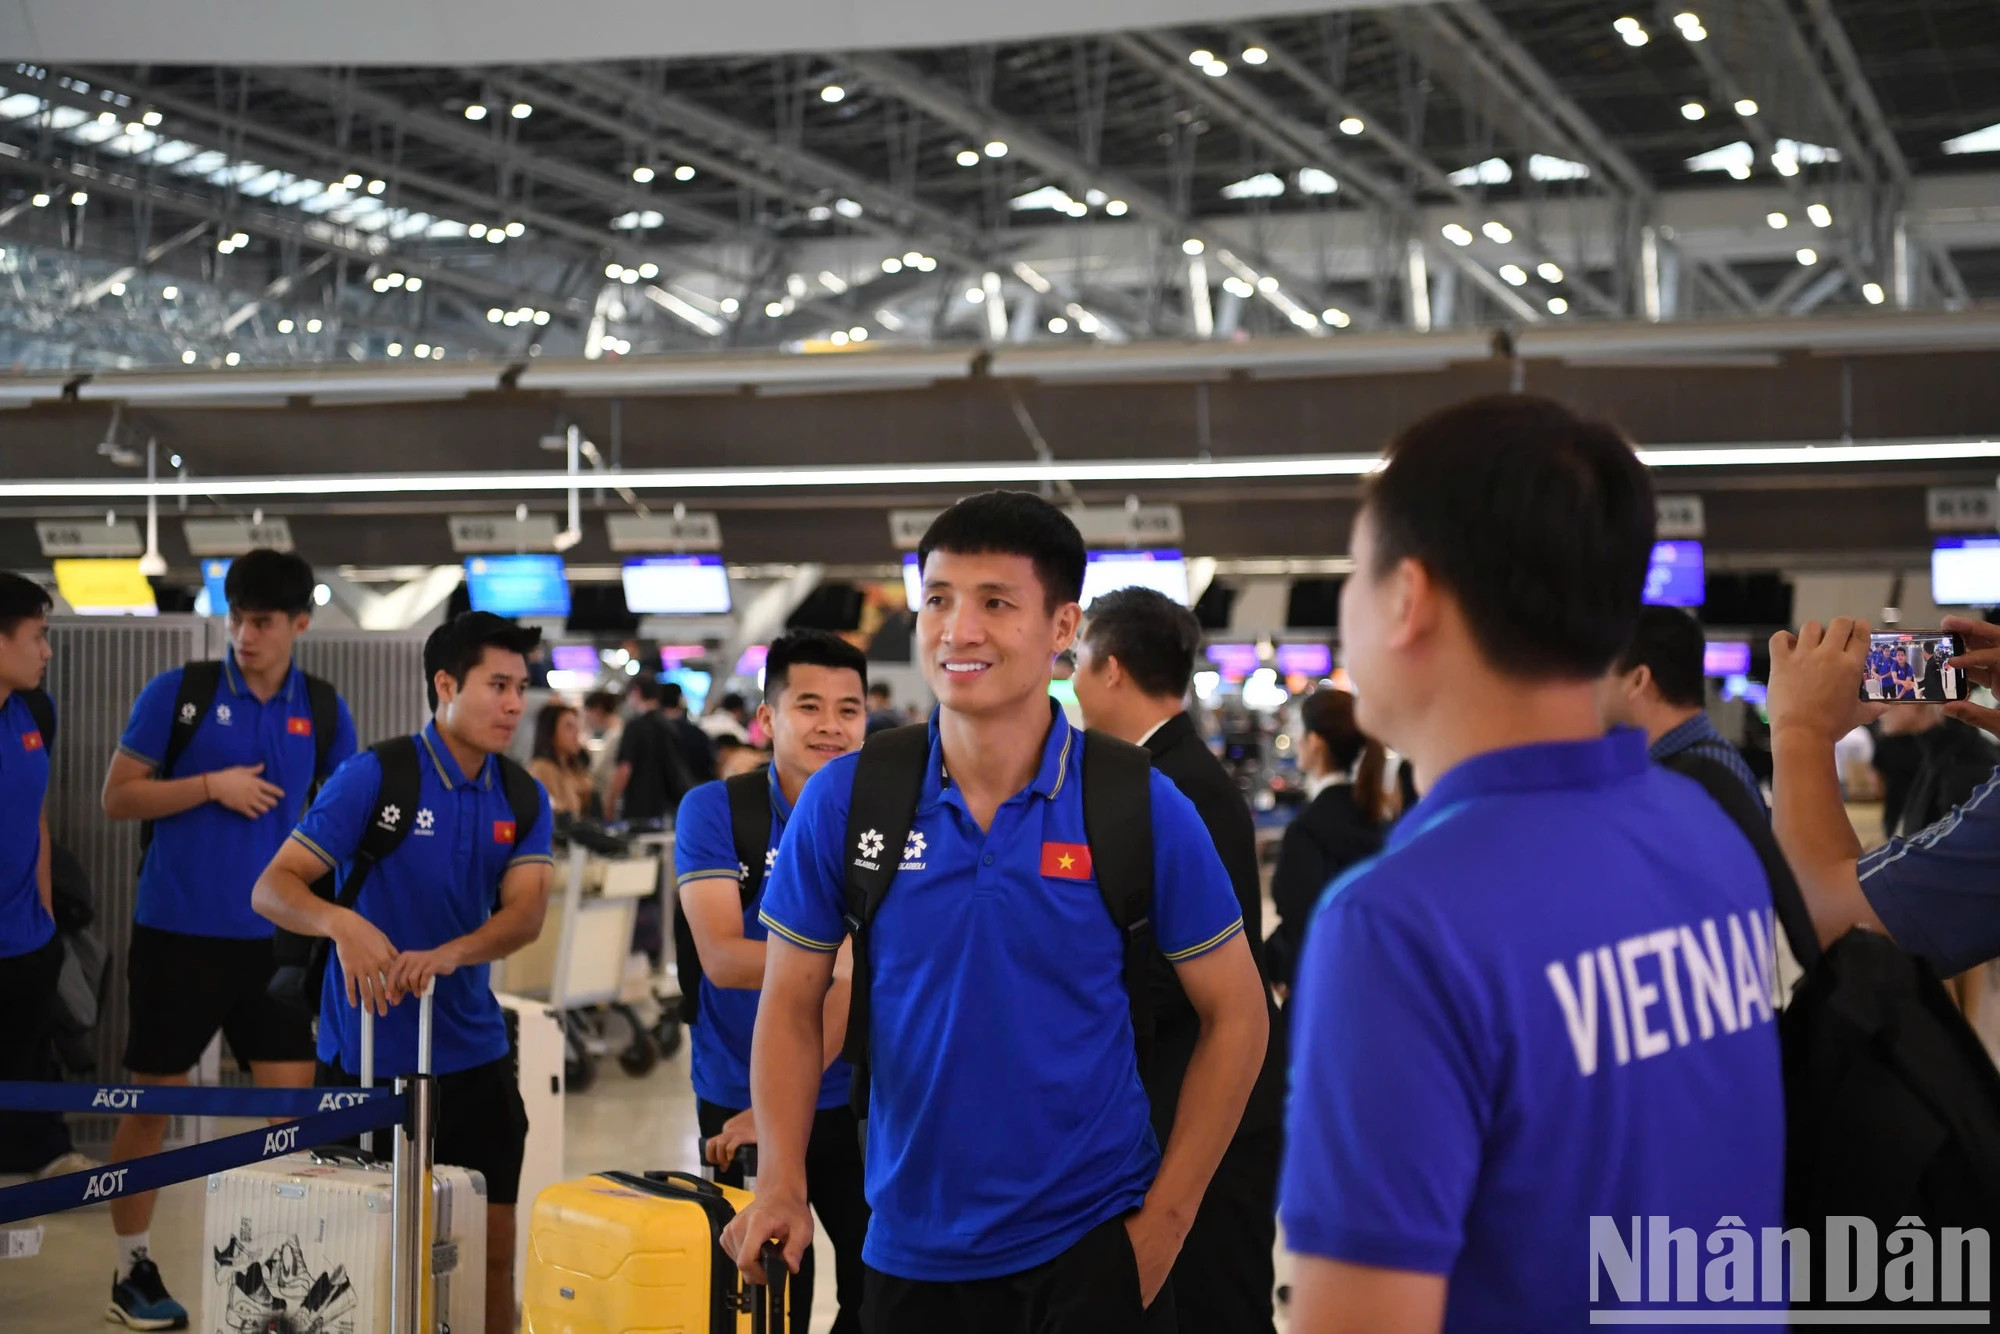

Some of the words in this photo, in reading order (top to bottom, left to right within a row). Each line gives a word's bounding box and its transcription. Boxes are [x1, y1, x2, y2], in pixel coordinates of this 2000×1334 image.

[92, 1088, 144, 1109] AOT
[317, 1092, 370, 1112] AOT
[262, 1126, 300, 1156] AOT
[82, 1168, 129, 1201] AOT
